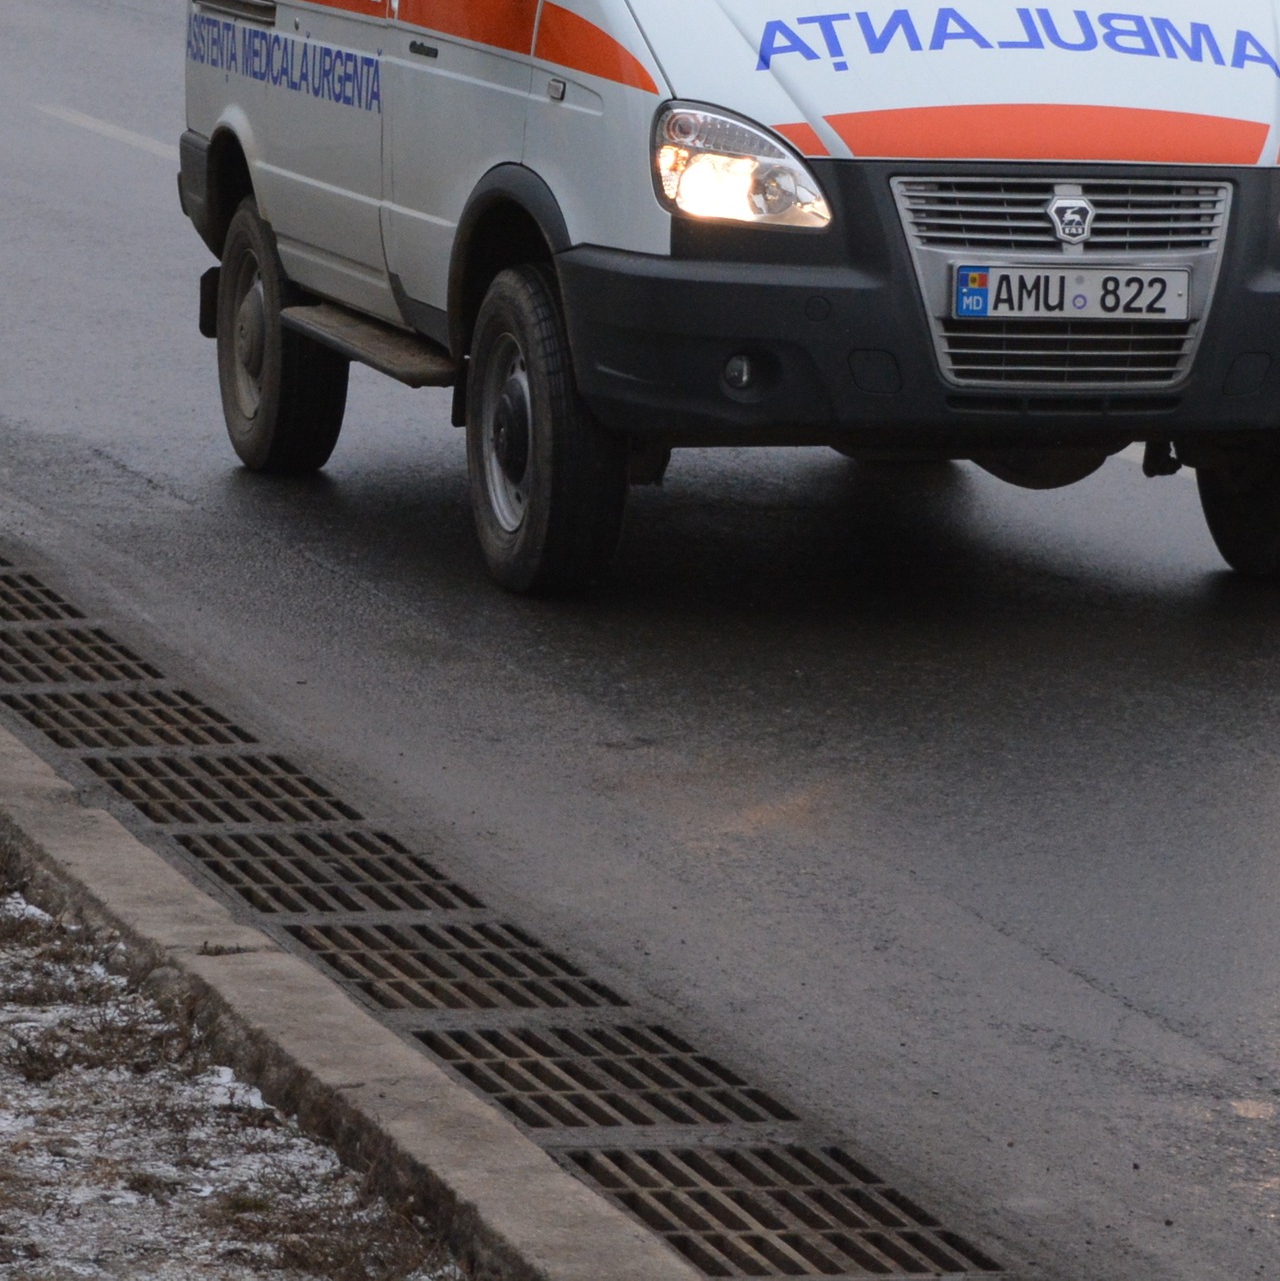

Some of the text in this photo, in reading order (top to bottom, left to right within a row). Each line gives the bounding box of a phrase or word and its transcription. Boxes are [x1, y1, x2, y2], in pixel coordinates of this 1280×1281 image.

[962, 295, 984, 311] MD
[992, 273, 1168, 315] AMU 822
